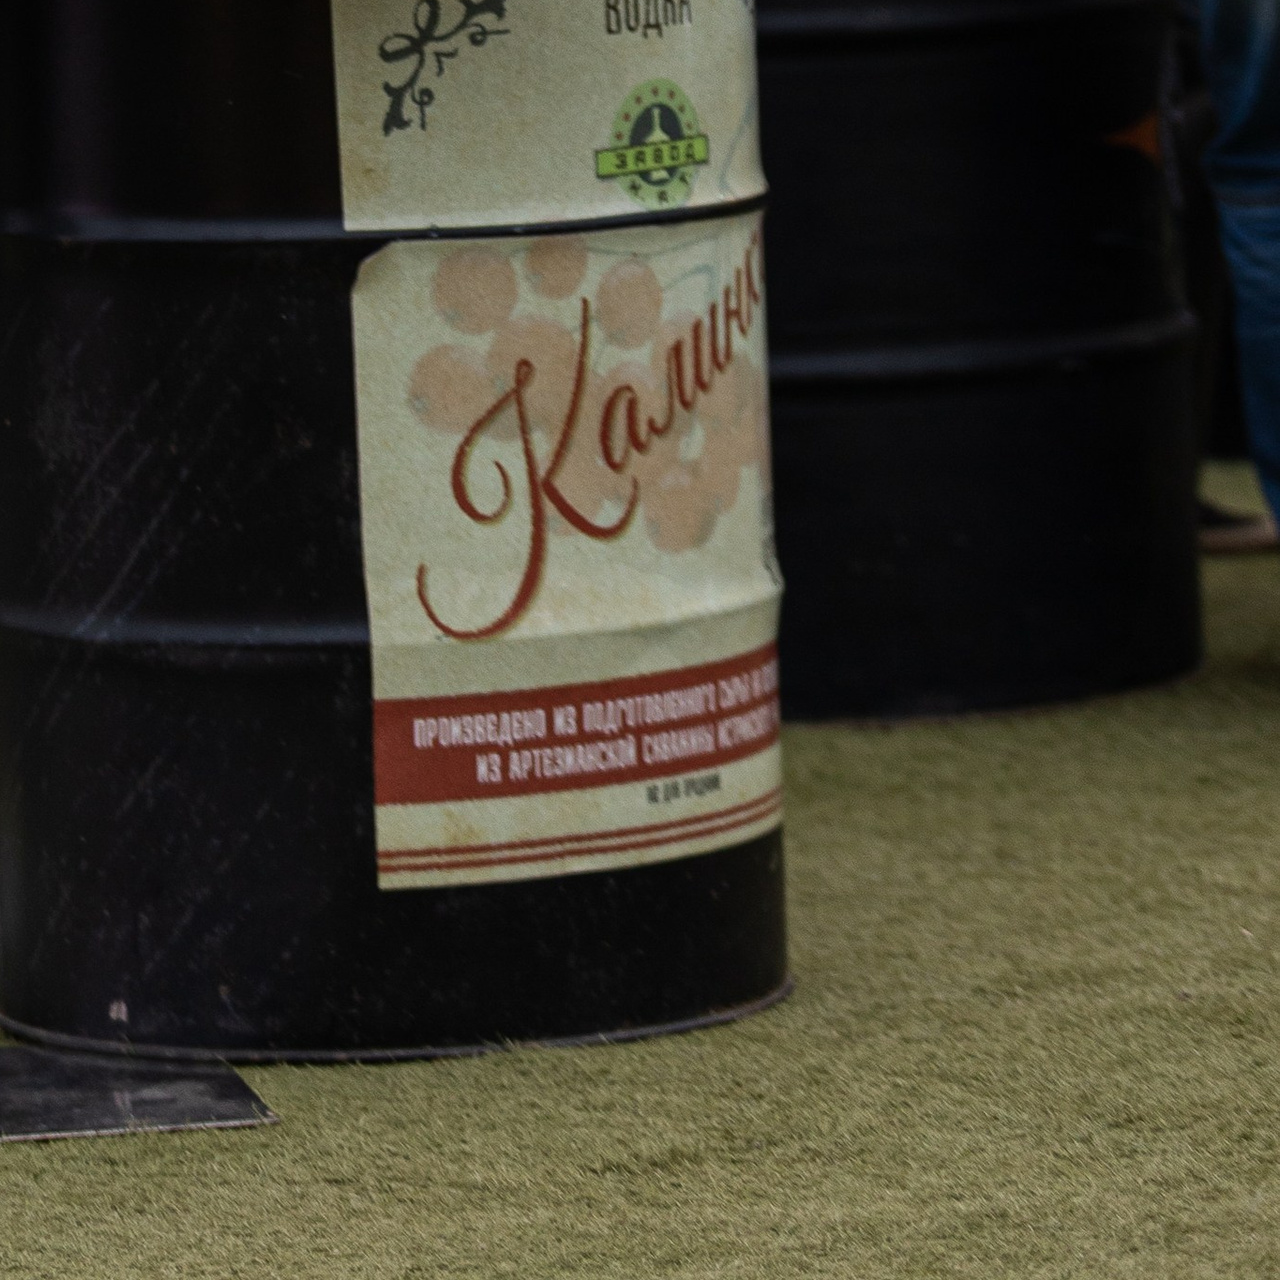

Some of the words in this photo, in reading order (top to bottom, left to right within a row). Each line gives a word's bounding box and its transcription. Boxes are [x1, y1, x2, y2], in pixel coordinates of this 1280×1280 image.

[615, 142, 697, 170] ЗАВОД
[413, 708, 547, 748] ПРОИЗВЕДЕНО
[552, 704, 577, 736] ИЗ
[476, 752, 502, 783] ИЗ
